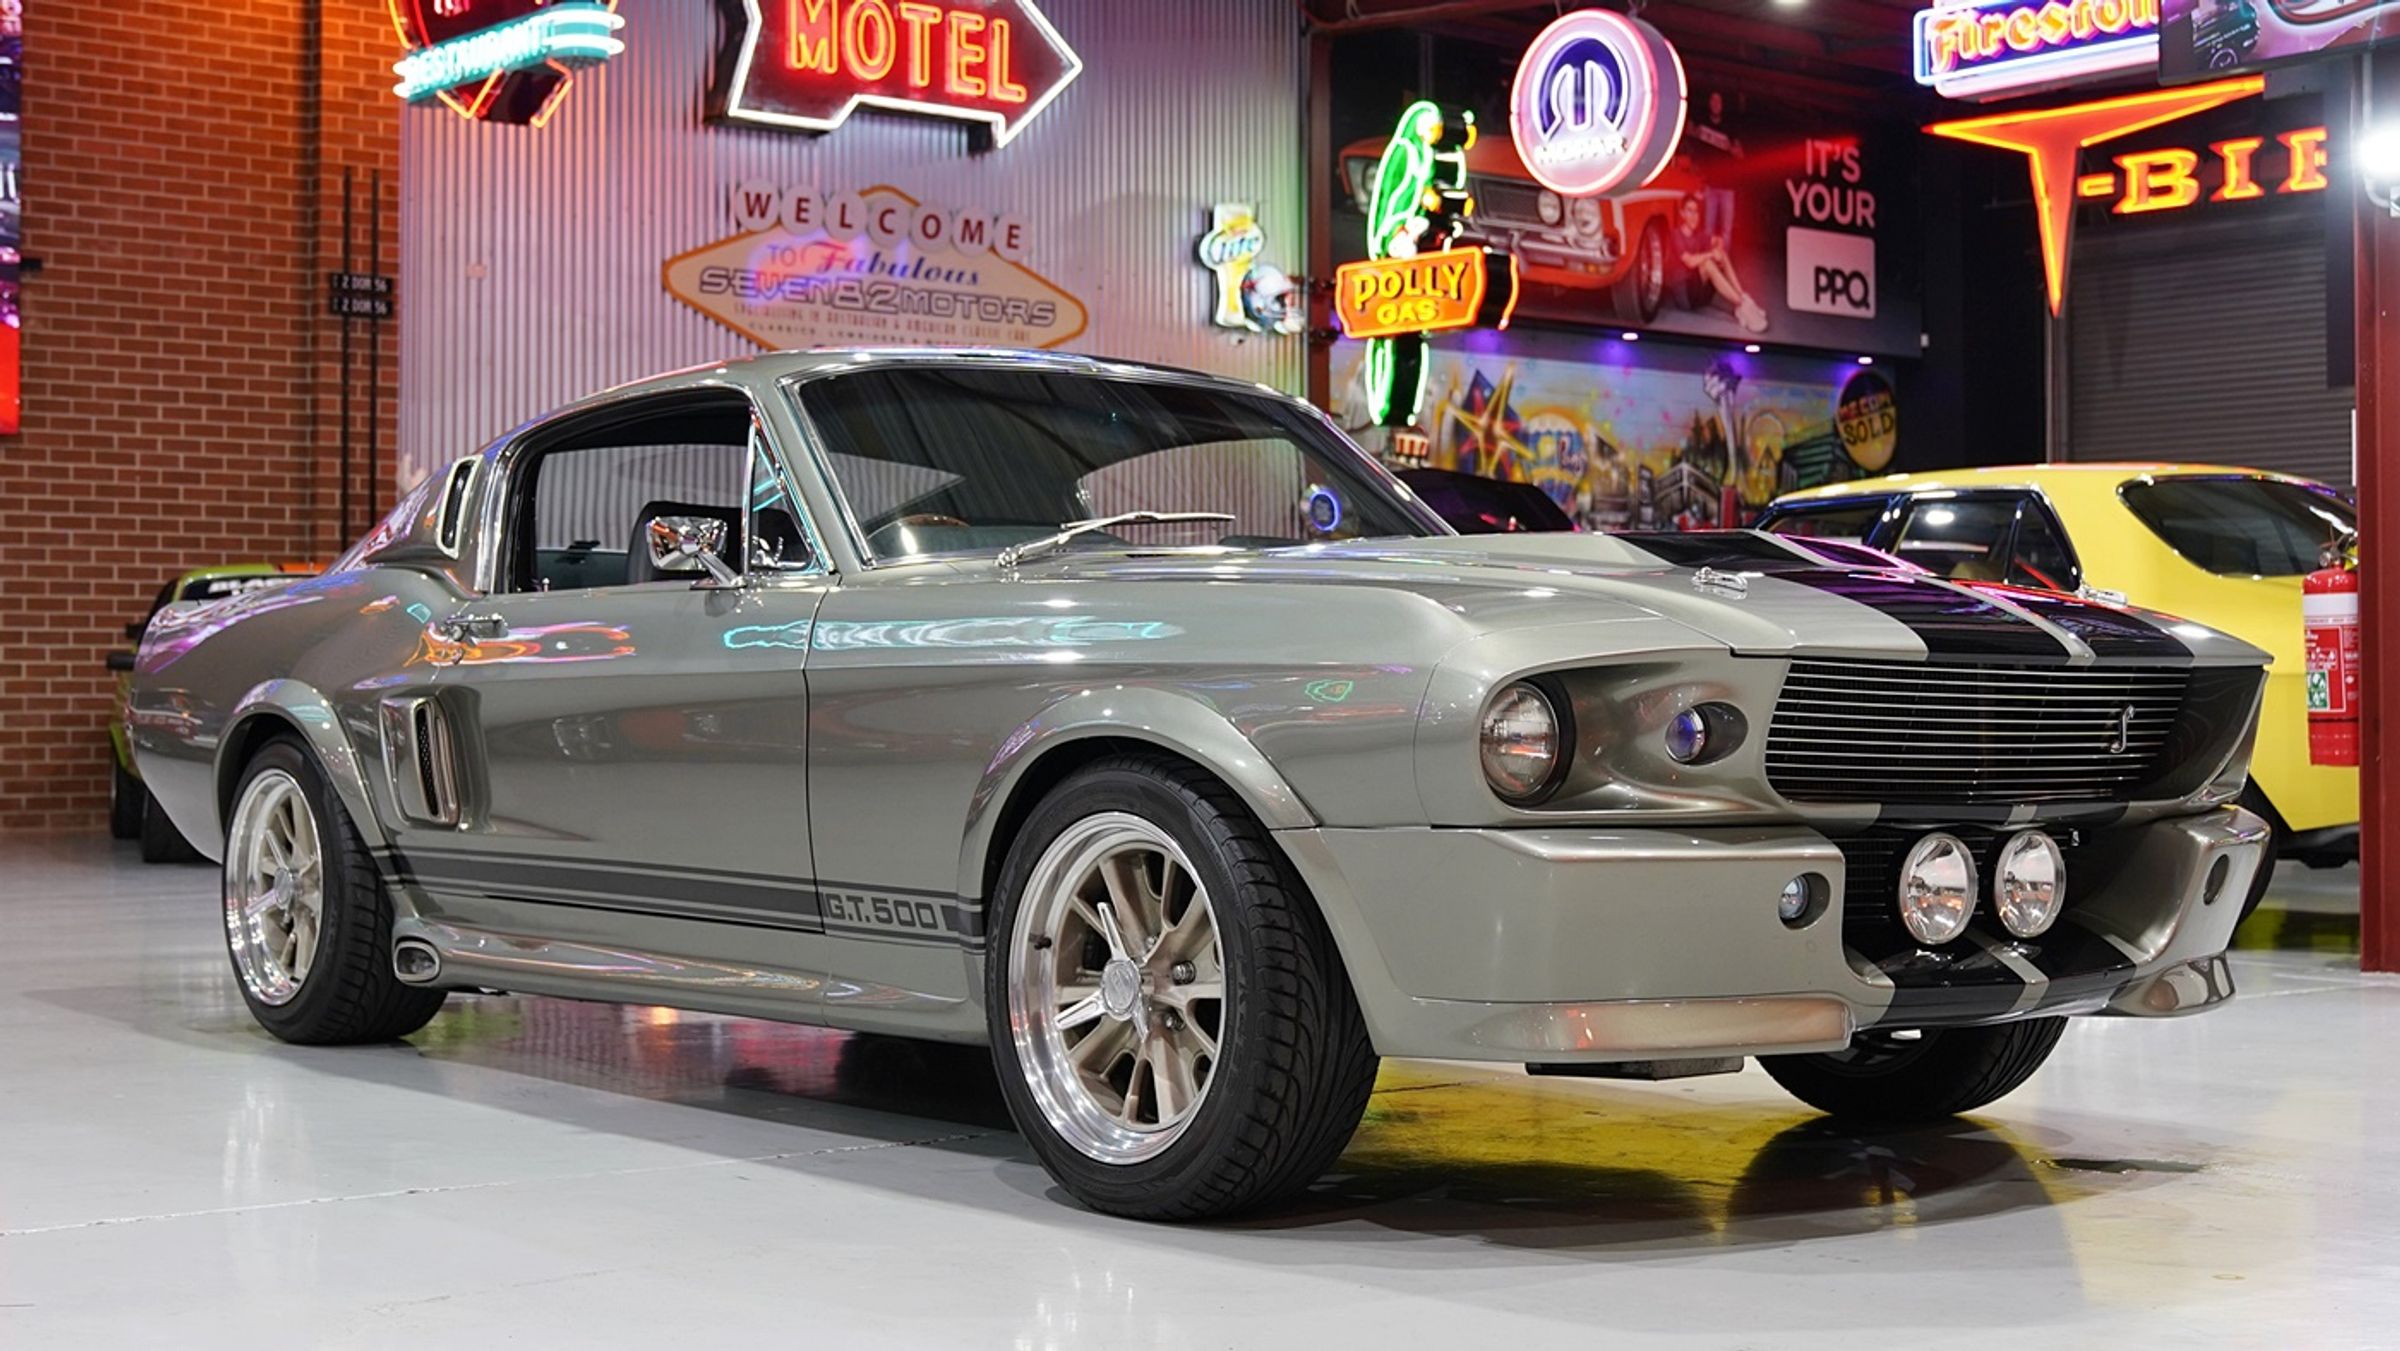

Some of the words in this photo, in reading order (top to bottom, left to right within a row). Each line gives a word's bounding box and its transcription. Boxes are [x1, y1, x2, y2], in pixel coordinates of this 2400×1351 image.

[785, 0, 1028, 103] MOTEL
[744, 191, 1022, 250] WELCOME
[1785, 178, 1876, 229] YOUR
[766, 243, 797, 268] TO
[802, 240, 981, 287] Fabulous
[1352, 261, 1468, 313] POLLY
[1813, 265, 1871, 310] PPQ
[1376, 298, 1439, 325] GAS
[1843, 411, 1894, 447] SOLD
